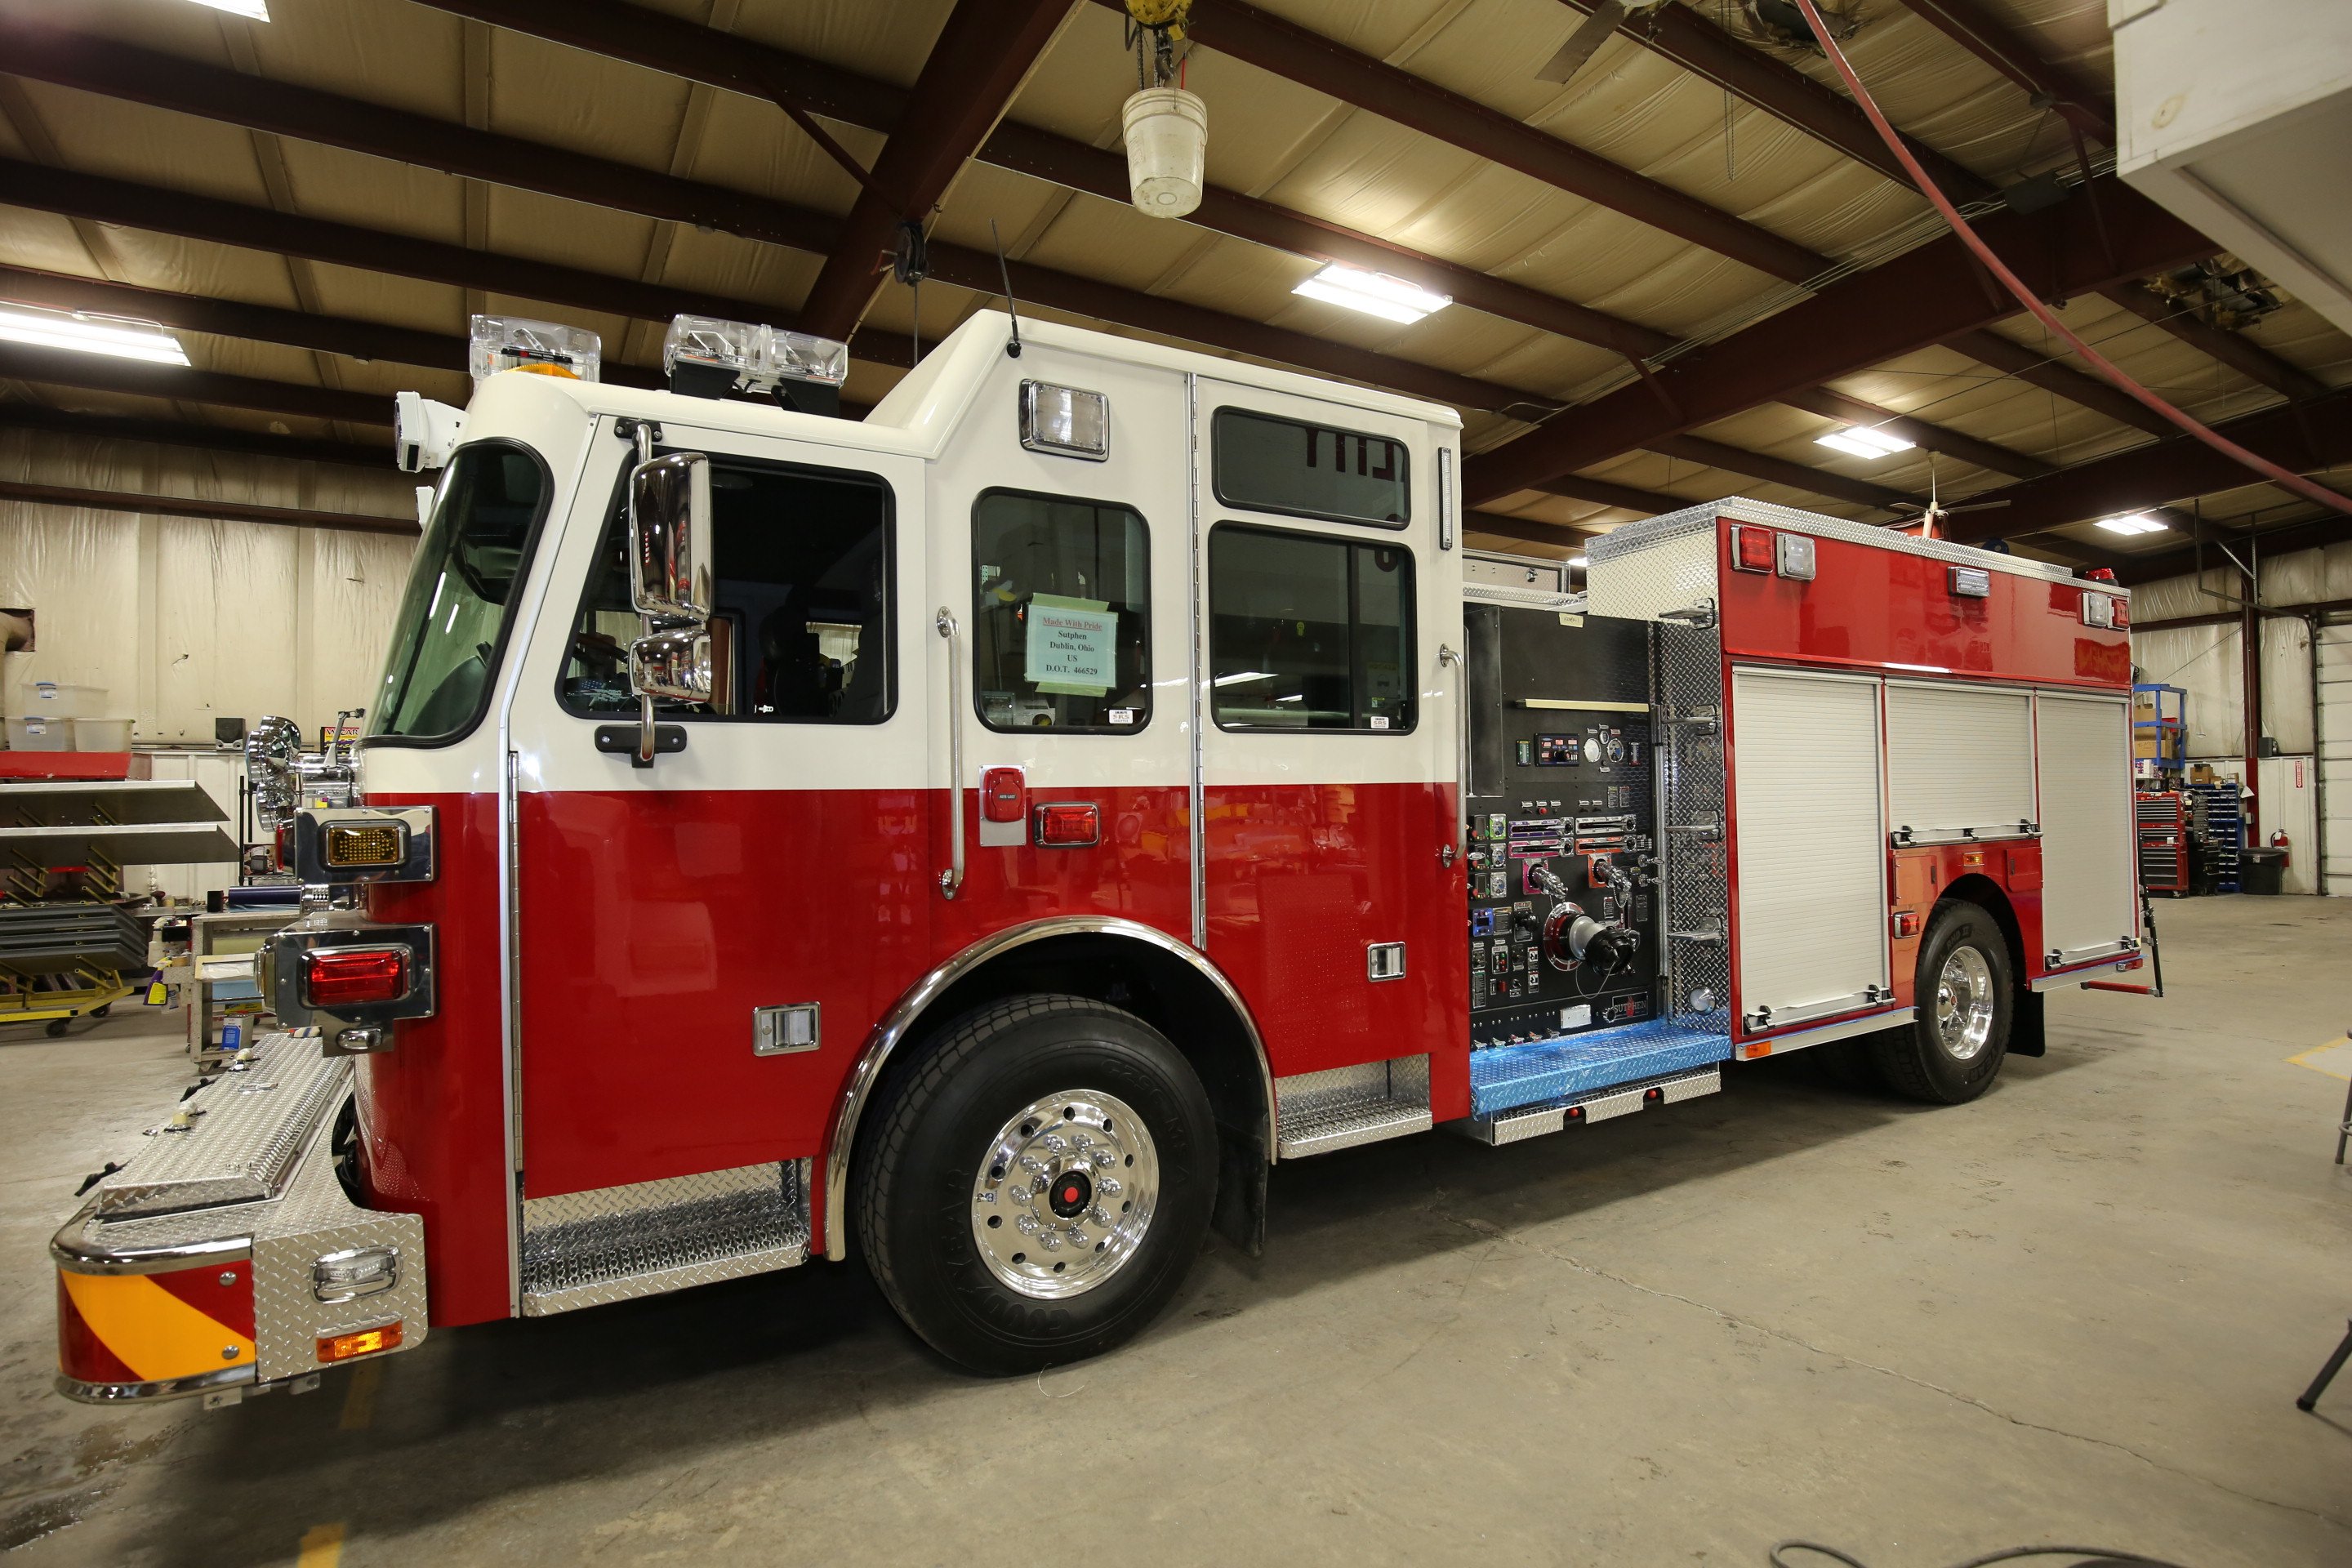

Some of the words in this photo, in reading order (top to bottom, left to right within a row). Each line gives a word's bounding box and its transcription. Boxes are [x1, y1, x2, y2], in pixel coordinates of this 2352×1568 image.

[1043, 617, 1063, 626] Made
[1065, 619, 1083, 628] With
[1084, 621, 1102, 630] Pride
[1058, 630, 1087, 640] Sutphen
[1049, 641, 1076, 651] Dublin,
[1078, 644, 1094, 652] Ohio
[1067, 654, 1078, 662] US
[1046, 664, 1070, 674] D.O.T.
[1074, 666, 1098, 675] 466529
[1614, 1000, 1646, 1013] SUTPHEN
